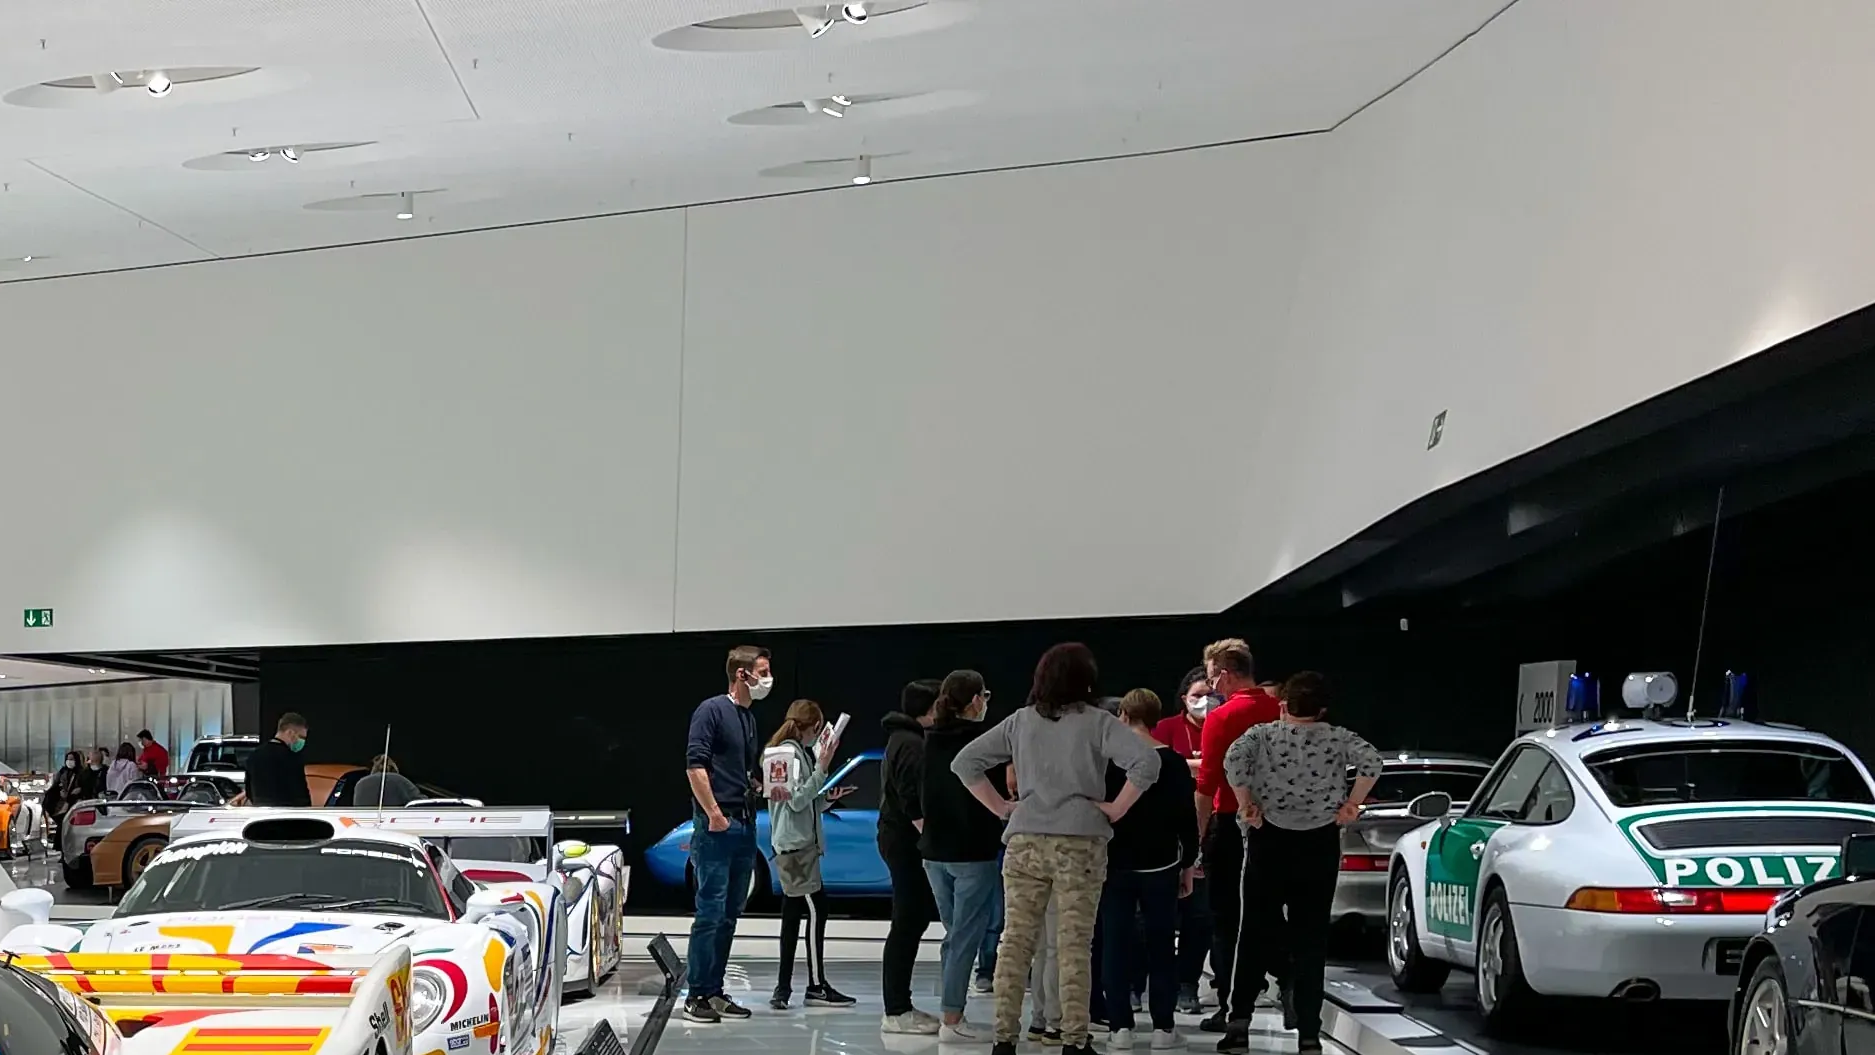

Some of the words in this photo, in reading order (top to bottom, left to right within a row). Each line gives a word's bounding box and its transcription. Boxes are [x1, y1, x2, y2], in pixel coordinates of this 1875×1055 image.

[1533, 690, 1554, 723] 2000
[1429, 881, 1470, 927] POLIZEI
[369, 1001, 392, 1040] Shell
[450, 1013, 490, 1032] MICHELIN
